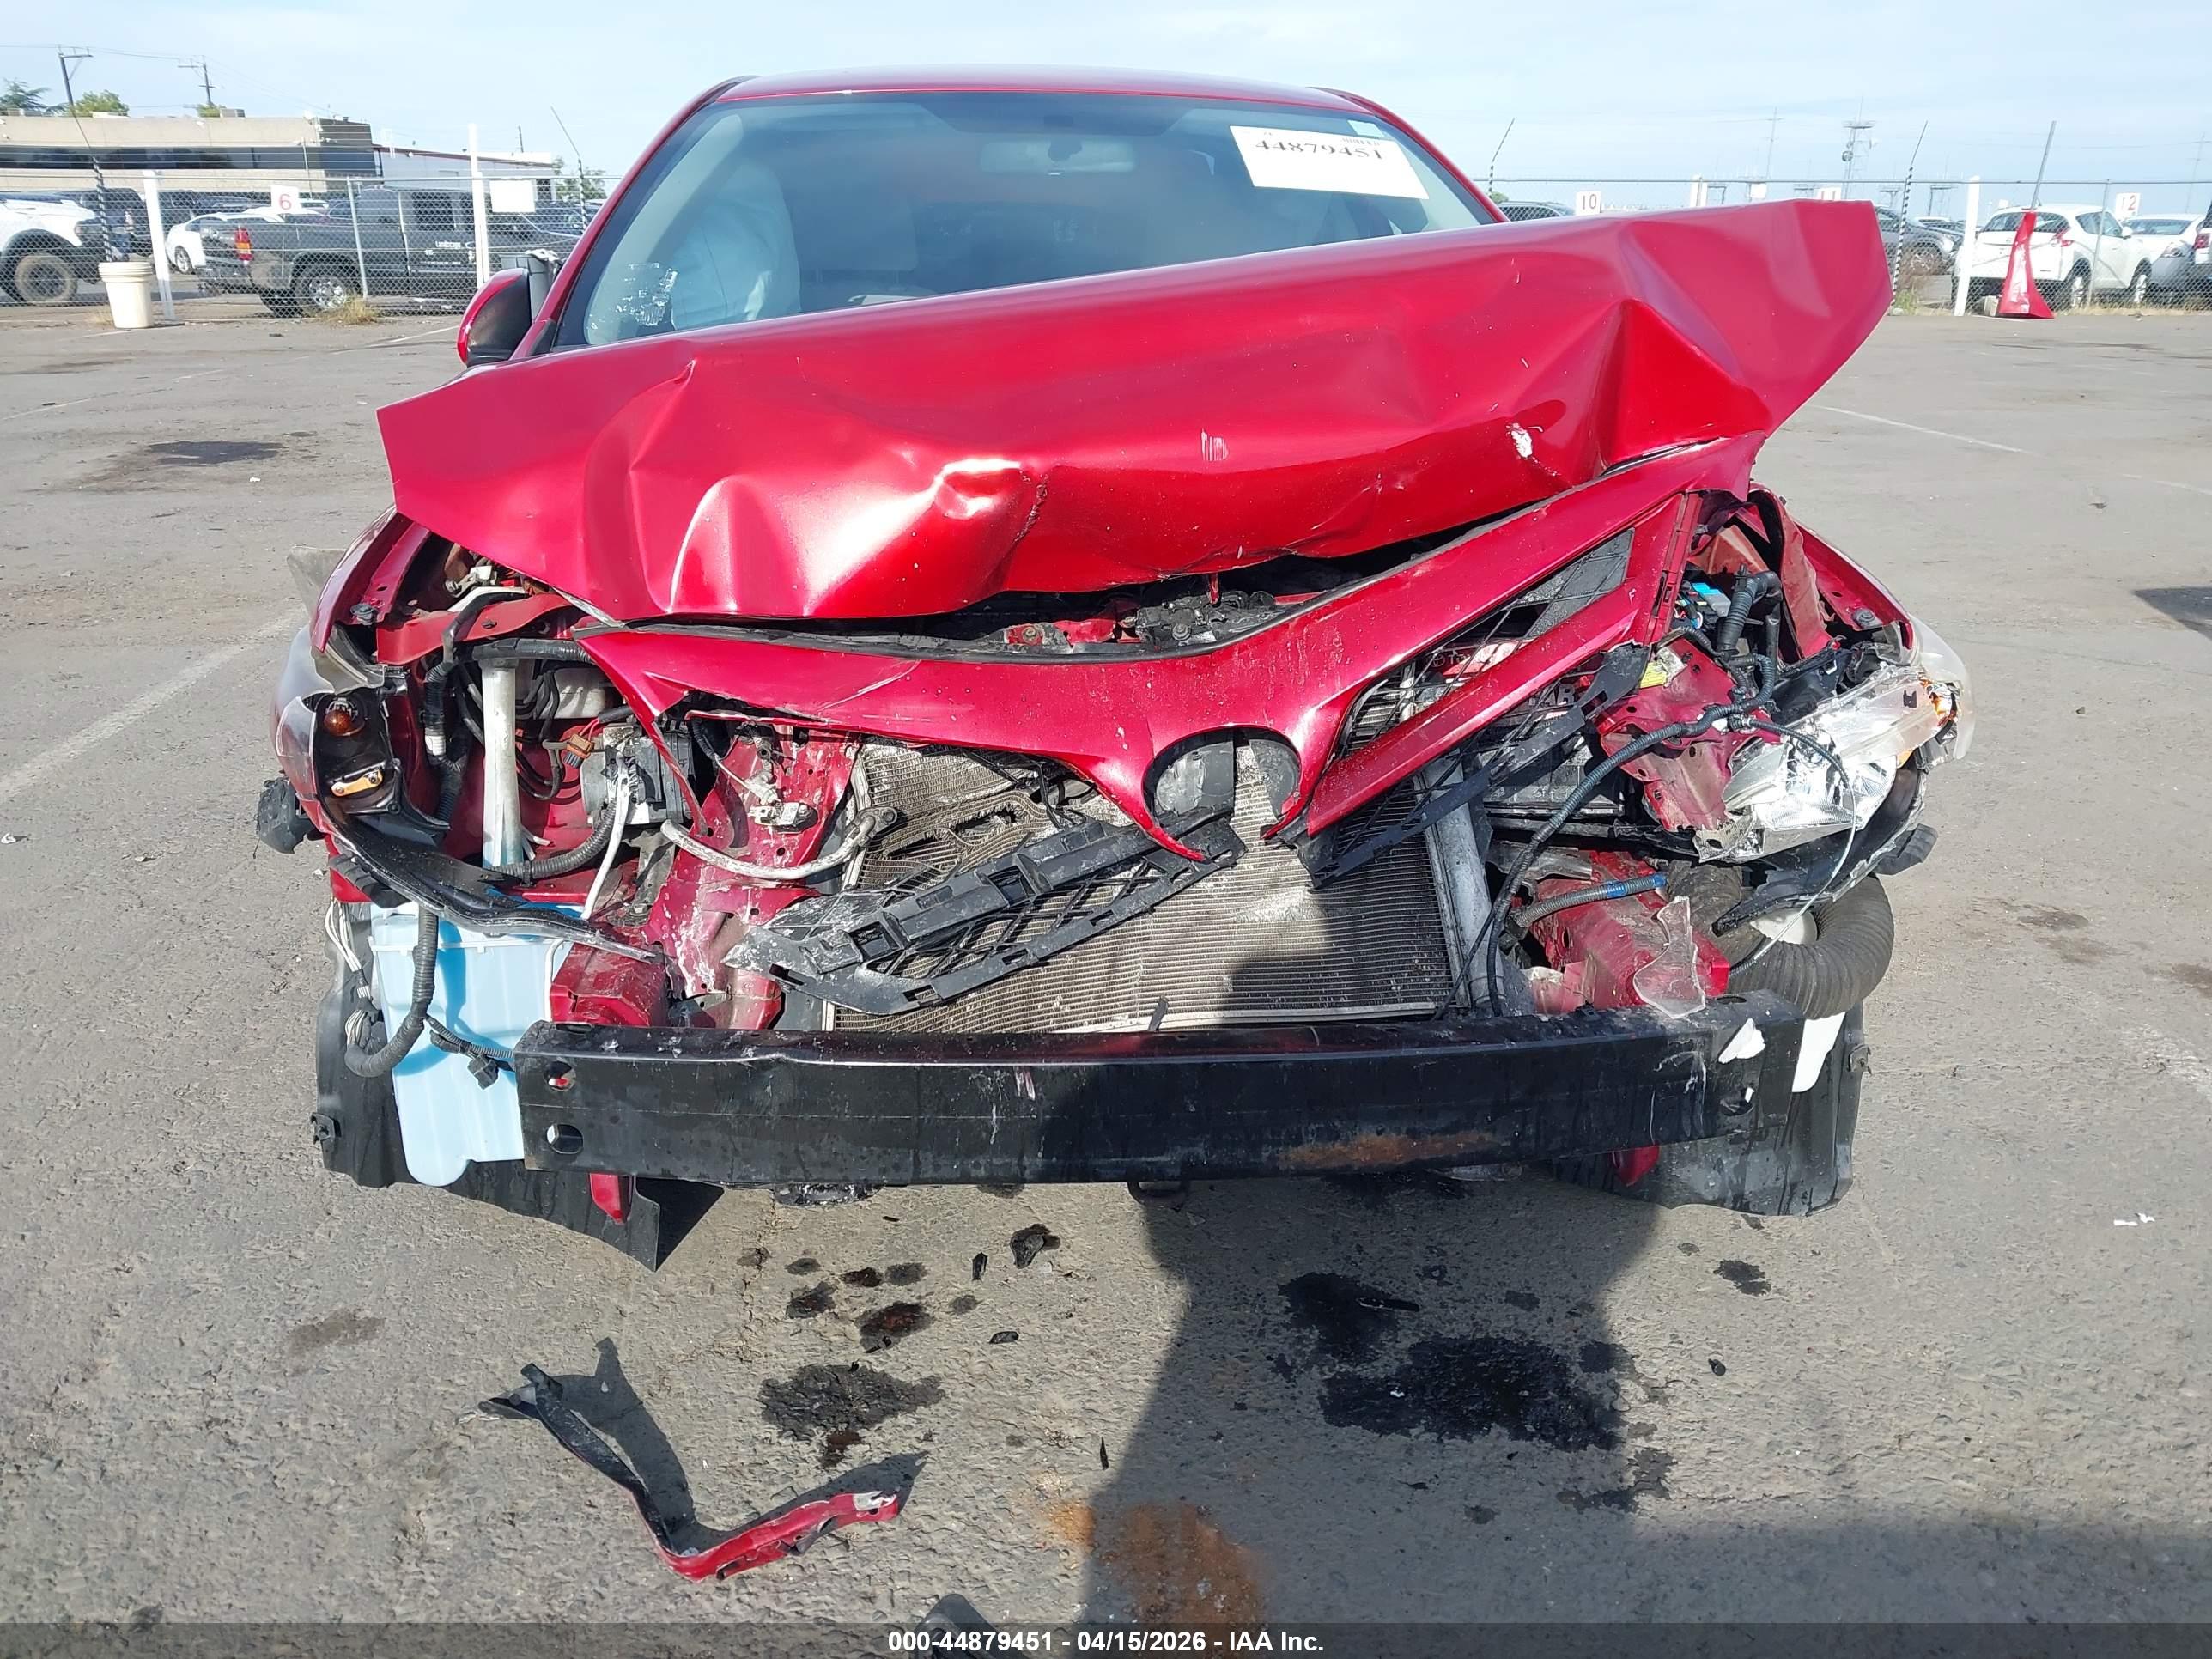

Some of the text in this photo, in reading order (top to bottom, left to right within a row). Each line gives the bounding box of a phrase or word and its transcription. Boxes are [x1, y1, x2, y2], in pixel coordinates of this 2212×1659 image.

[1255, 140, 1382, 160] 44879451
[278, 193, 293, 210] 6
[1583, 193, 1597, 210] 10
